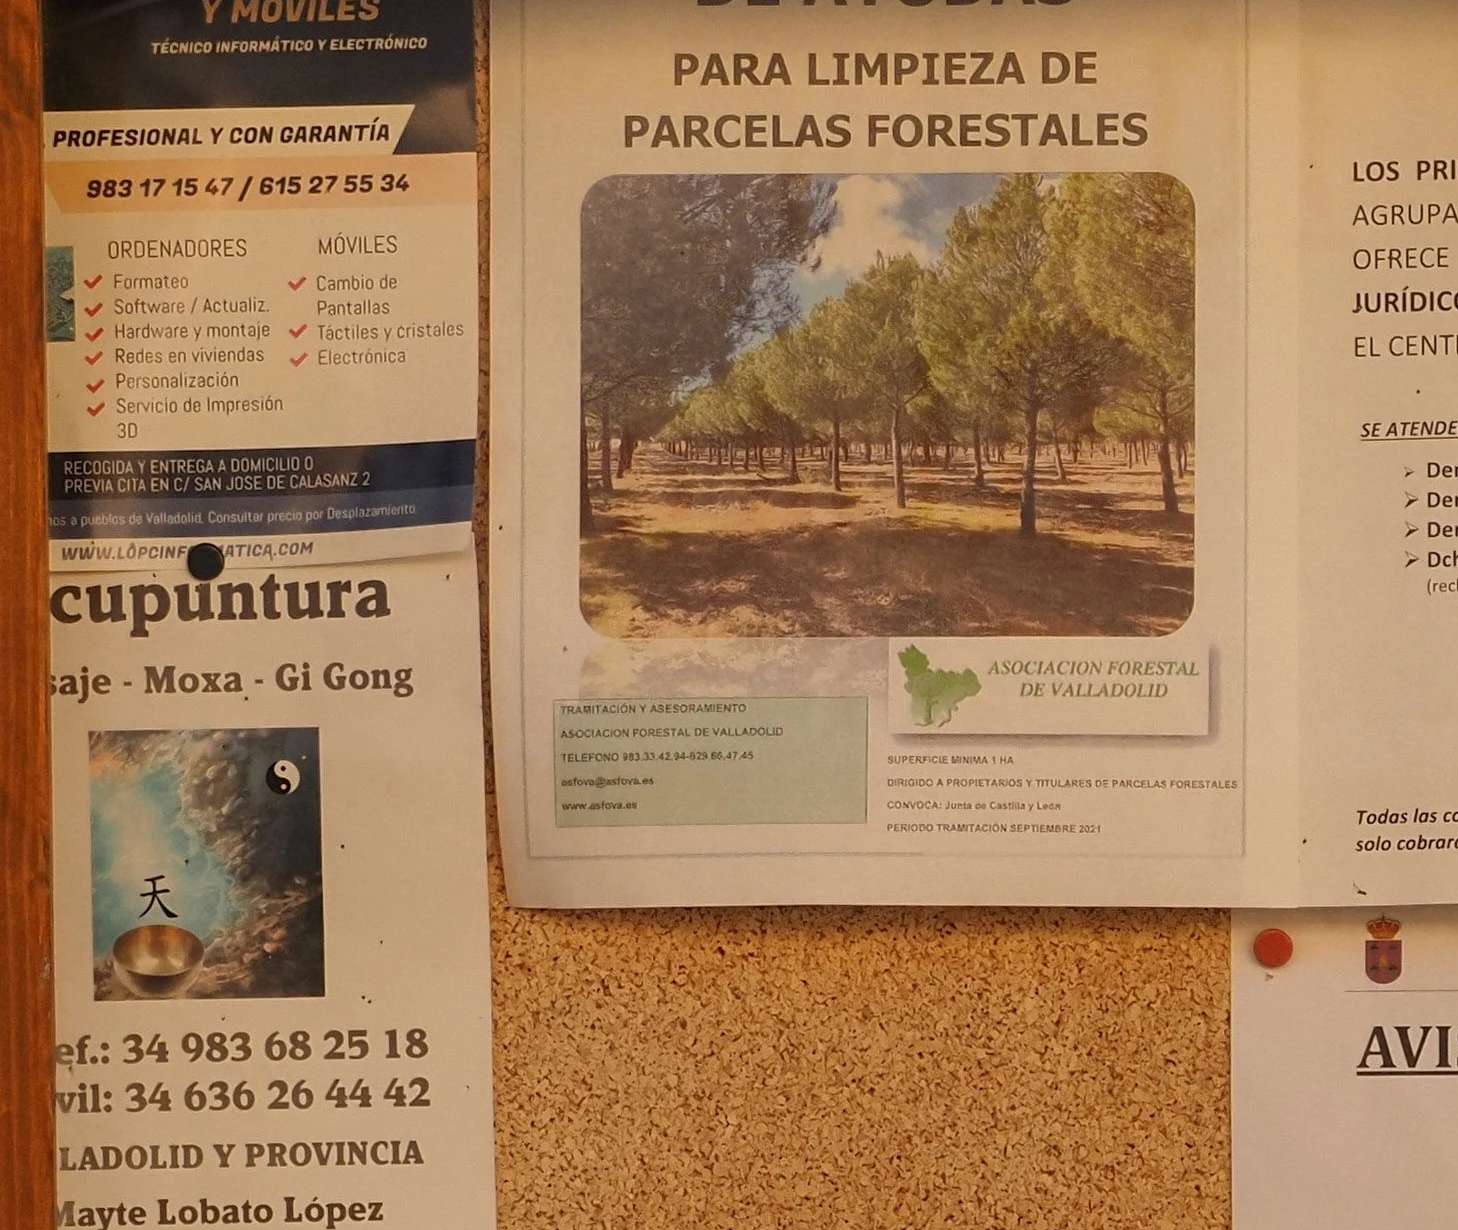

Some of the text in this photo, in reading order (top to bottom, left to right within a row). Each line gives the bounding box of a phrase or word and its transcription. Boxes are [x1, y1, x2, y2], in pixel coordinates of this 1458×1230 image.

[151, 34, 427, 54] TÉCNICO INFORMÁTICO Y ELECTRÓNICO
[675, 52, 1097, 85] PARA LIMPIEZA DE
[53, 117, 388, 147] PROFESIONAL Y CON GARANTÍA
[625, 113, 1147, 148] PARCELAS FORESTALES
[1354, 161, 1399, 181] LOS
[87, 180, 132, 198] 983
[140, 179, 165, 196] 17
[172, 178, 198, 196] 15
[205, 178, 233, 195] 47
[260, 176, 301, 195] 615
[309, 176, 338, 193] 27
[344, 175, 373, 193] 55
[380, 174, 409, 192] 34
[108, 239, 246, 259] ORDENADORES
[319, 232, 397, 254] MÓVILES
[114, 274, 188, 289] Formateo
[317, 274, 397, 291] Cambio de
[318, 349, 405, 365] Electrónica
[64, 460, 133, 475] RECOGIDA
[138, 461, 145, 473] Y
[151, 459, 214, 474] ENTREGA
[218, 459, 226, 472] A
[231, 457, 299, 472] DOMICILIO
[988, 661, 1199, 676] ASOCIACION FORESTAL
[1020, 683, 1168, 697] DE VALLADOLID
[139, 875, 178, 918] 天
[123, 1034, 168, 1064] 34
[182, 1032, 252, 1062] 983
[265, 1031, 311, 1061] 68
[324, 1030, 369, 1059] 25
[385, 1028, 428, 1058] 18
